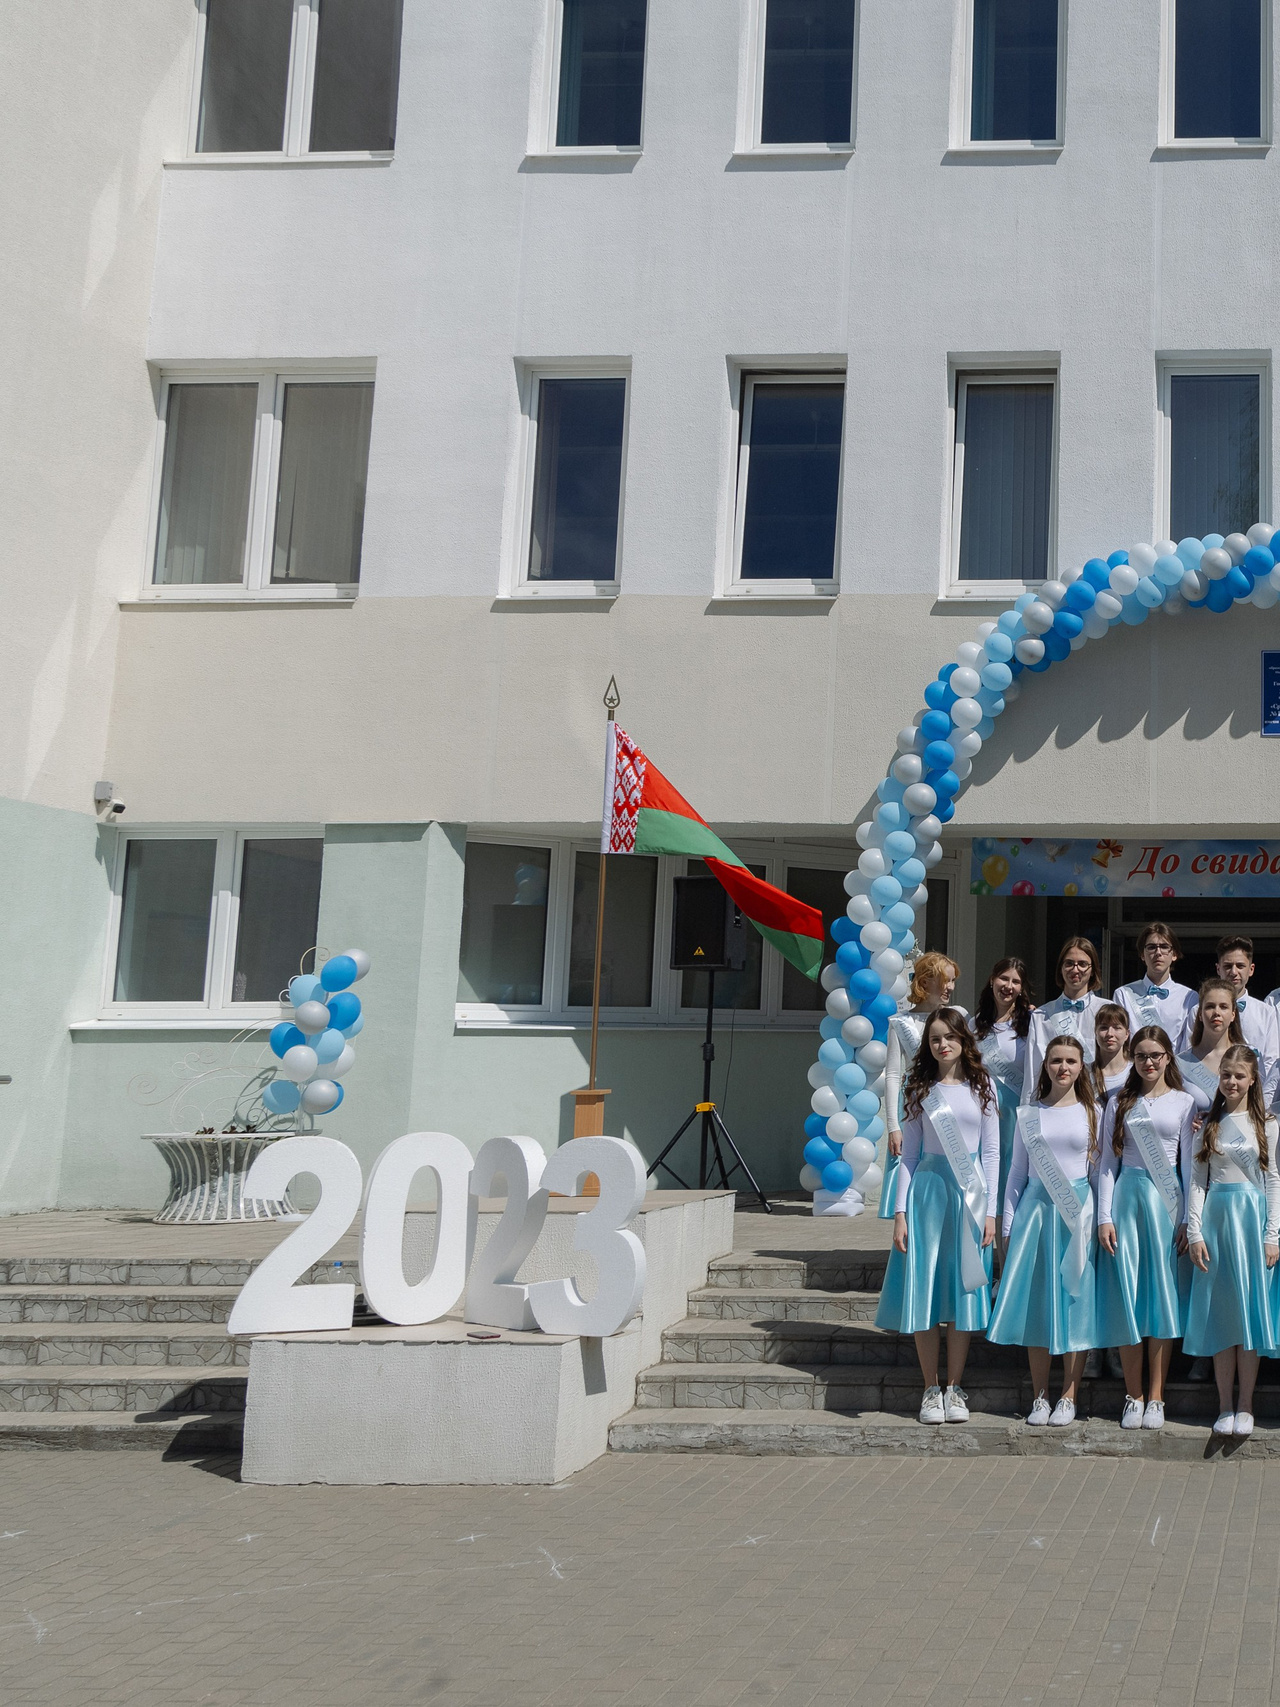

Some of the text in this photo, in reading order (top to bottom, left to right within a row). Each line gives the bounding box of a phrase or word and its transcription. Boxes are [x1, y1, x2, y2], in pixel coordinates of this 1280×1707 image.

[1127, 846, 1180, 881] До
[954, 1152, 975, 1185] 2024
[1027, 1117, 1082, 1220] Выпускница 2024
[1158, 1168, 1179, 1201] 2024
[227, 1131, 647, 1337] 2023
